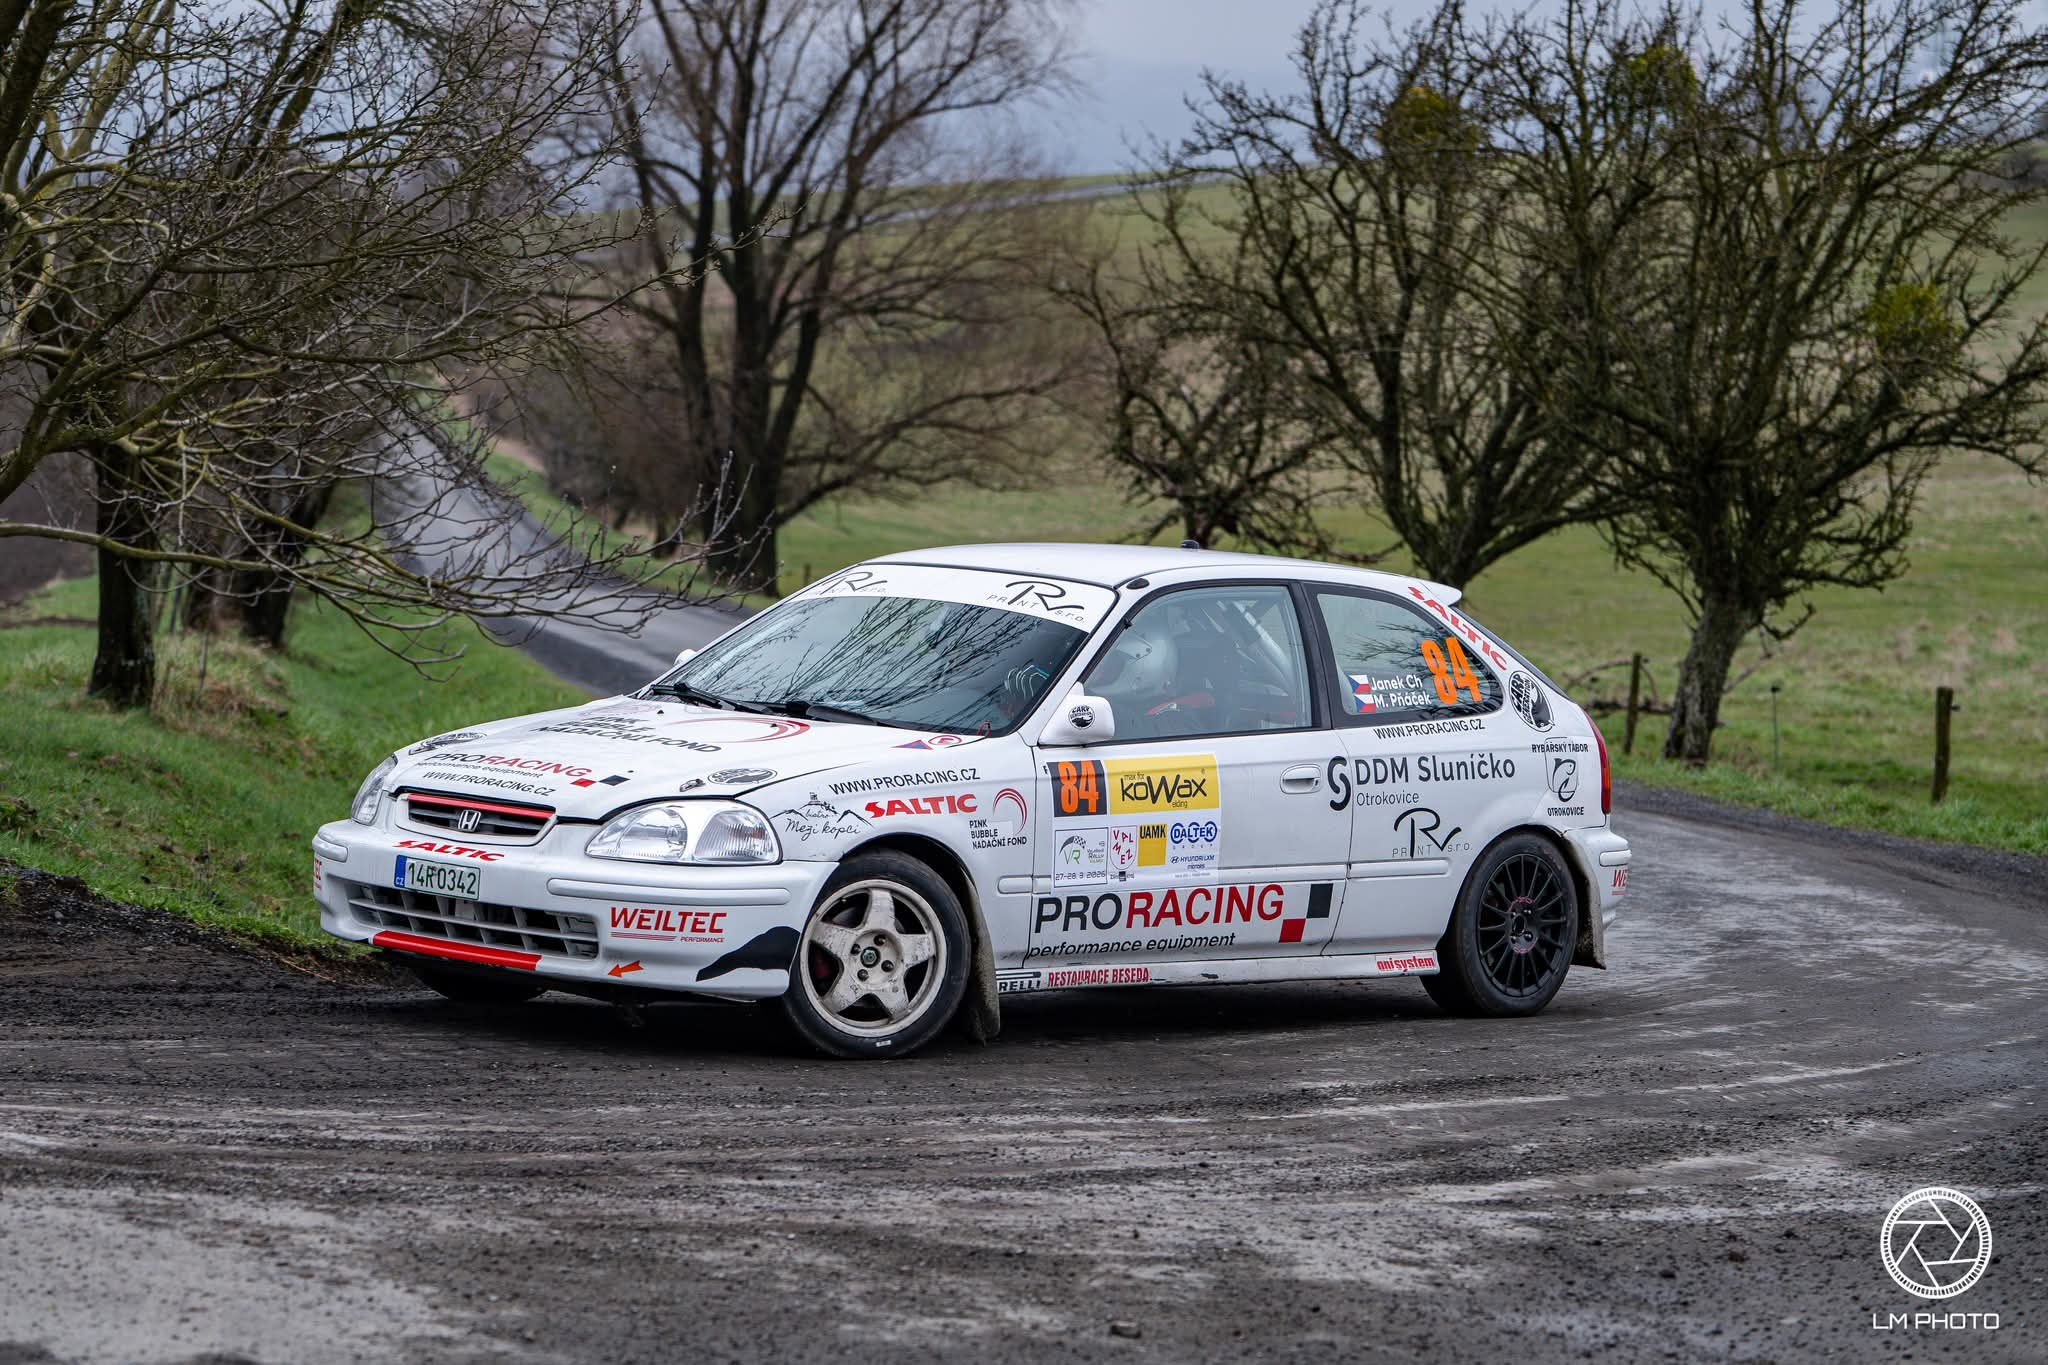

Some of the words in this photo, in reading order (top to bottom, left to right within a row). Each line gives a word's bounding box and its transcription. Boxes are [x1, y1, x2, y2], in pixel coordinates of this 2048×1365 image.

[1054, 609, 1085, 623] s.r.o.
[1408, 586, 1507, 670] SALTIC
[1420, 637, 1482, 705] 84
[1371, 675, 1406, 691] Janek
[1406, 674, 1423, 688] Ch
[1511, 673, 1525, 713] CARP
[1373, 693, 1389, 708] M.
[1373, 719, 1486, 740] WWW.PRORACING.CZ
[645, 736, 723, 753] FOND
[425, 753, 594, 778] PRORACING
[1355, 756, 1410, 786] DDM
[1417, 752, 1517, 783] Sluníčko
[422, 771, 557, 797] WWW.PRORACING.CZ
[828, 768, 981, 796] WWW.PRORACING.CZ
[1057, 760, 1099, 814] 84
[1120, 773, 1208, 805] koWax
[864, 793, 978, 819] SALTIC
[1356, 791, 1420, 807] Otrokovice
[1547, 806, 1585, 816] OTROKOVICE
[784, 817, 819, 842] Mezi
[969, 819, 988, 829] PINK
[970, 829, 999, 839] BUBBLE
[1139, 824, 1167, 839] UAMK
[392, 840, 505, 862] SALTIC
[972, 837, 1006, 850] NADAČNÍ
[1007, 836, 1028, 847] FOND
[1447, 842, 1473, 853] s.r.o.
[395, 876, 405, 886] CZ
[1033, 883, 1285, 934] PRORACING
[610, 906, 728, 934] WEILTEC
[1028, 937, 1142, 959] performance
[1146, 933, 1236, 952] equipment
[1047, 969, 1110, 988] RESTAURACE
[1111, 967, 1150, 983] BESEDA
